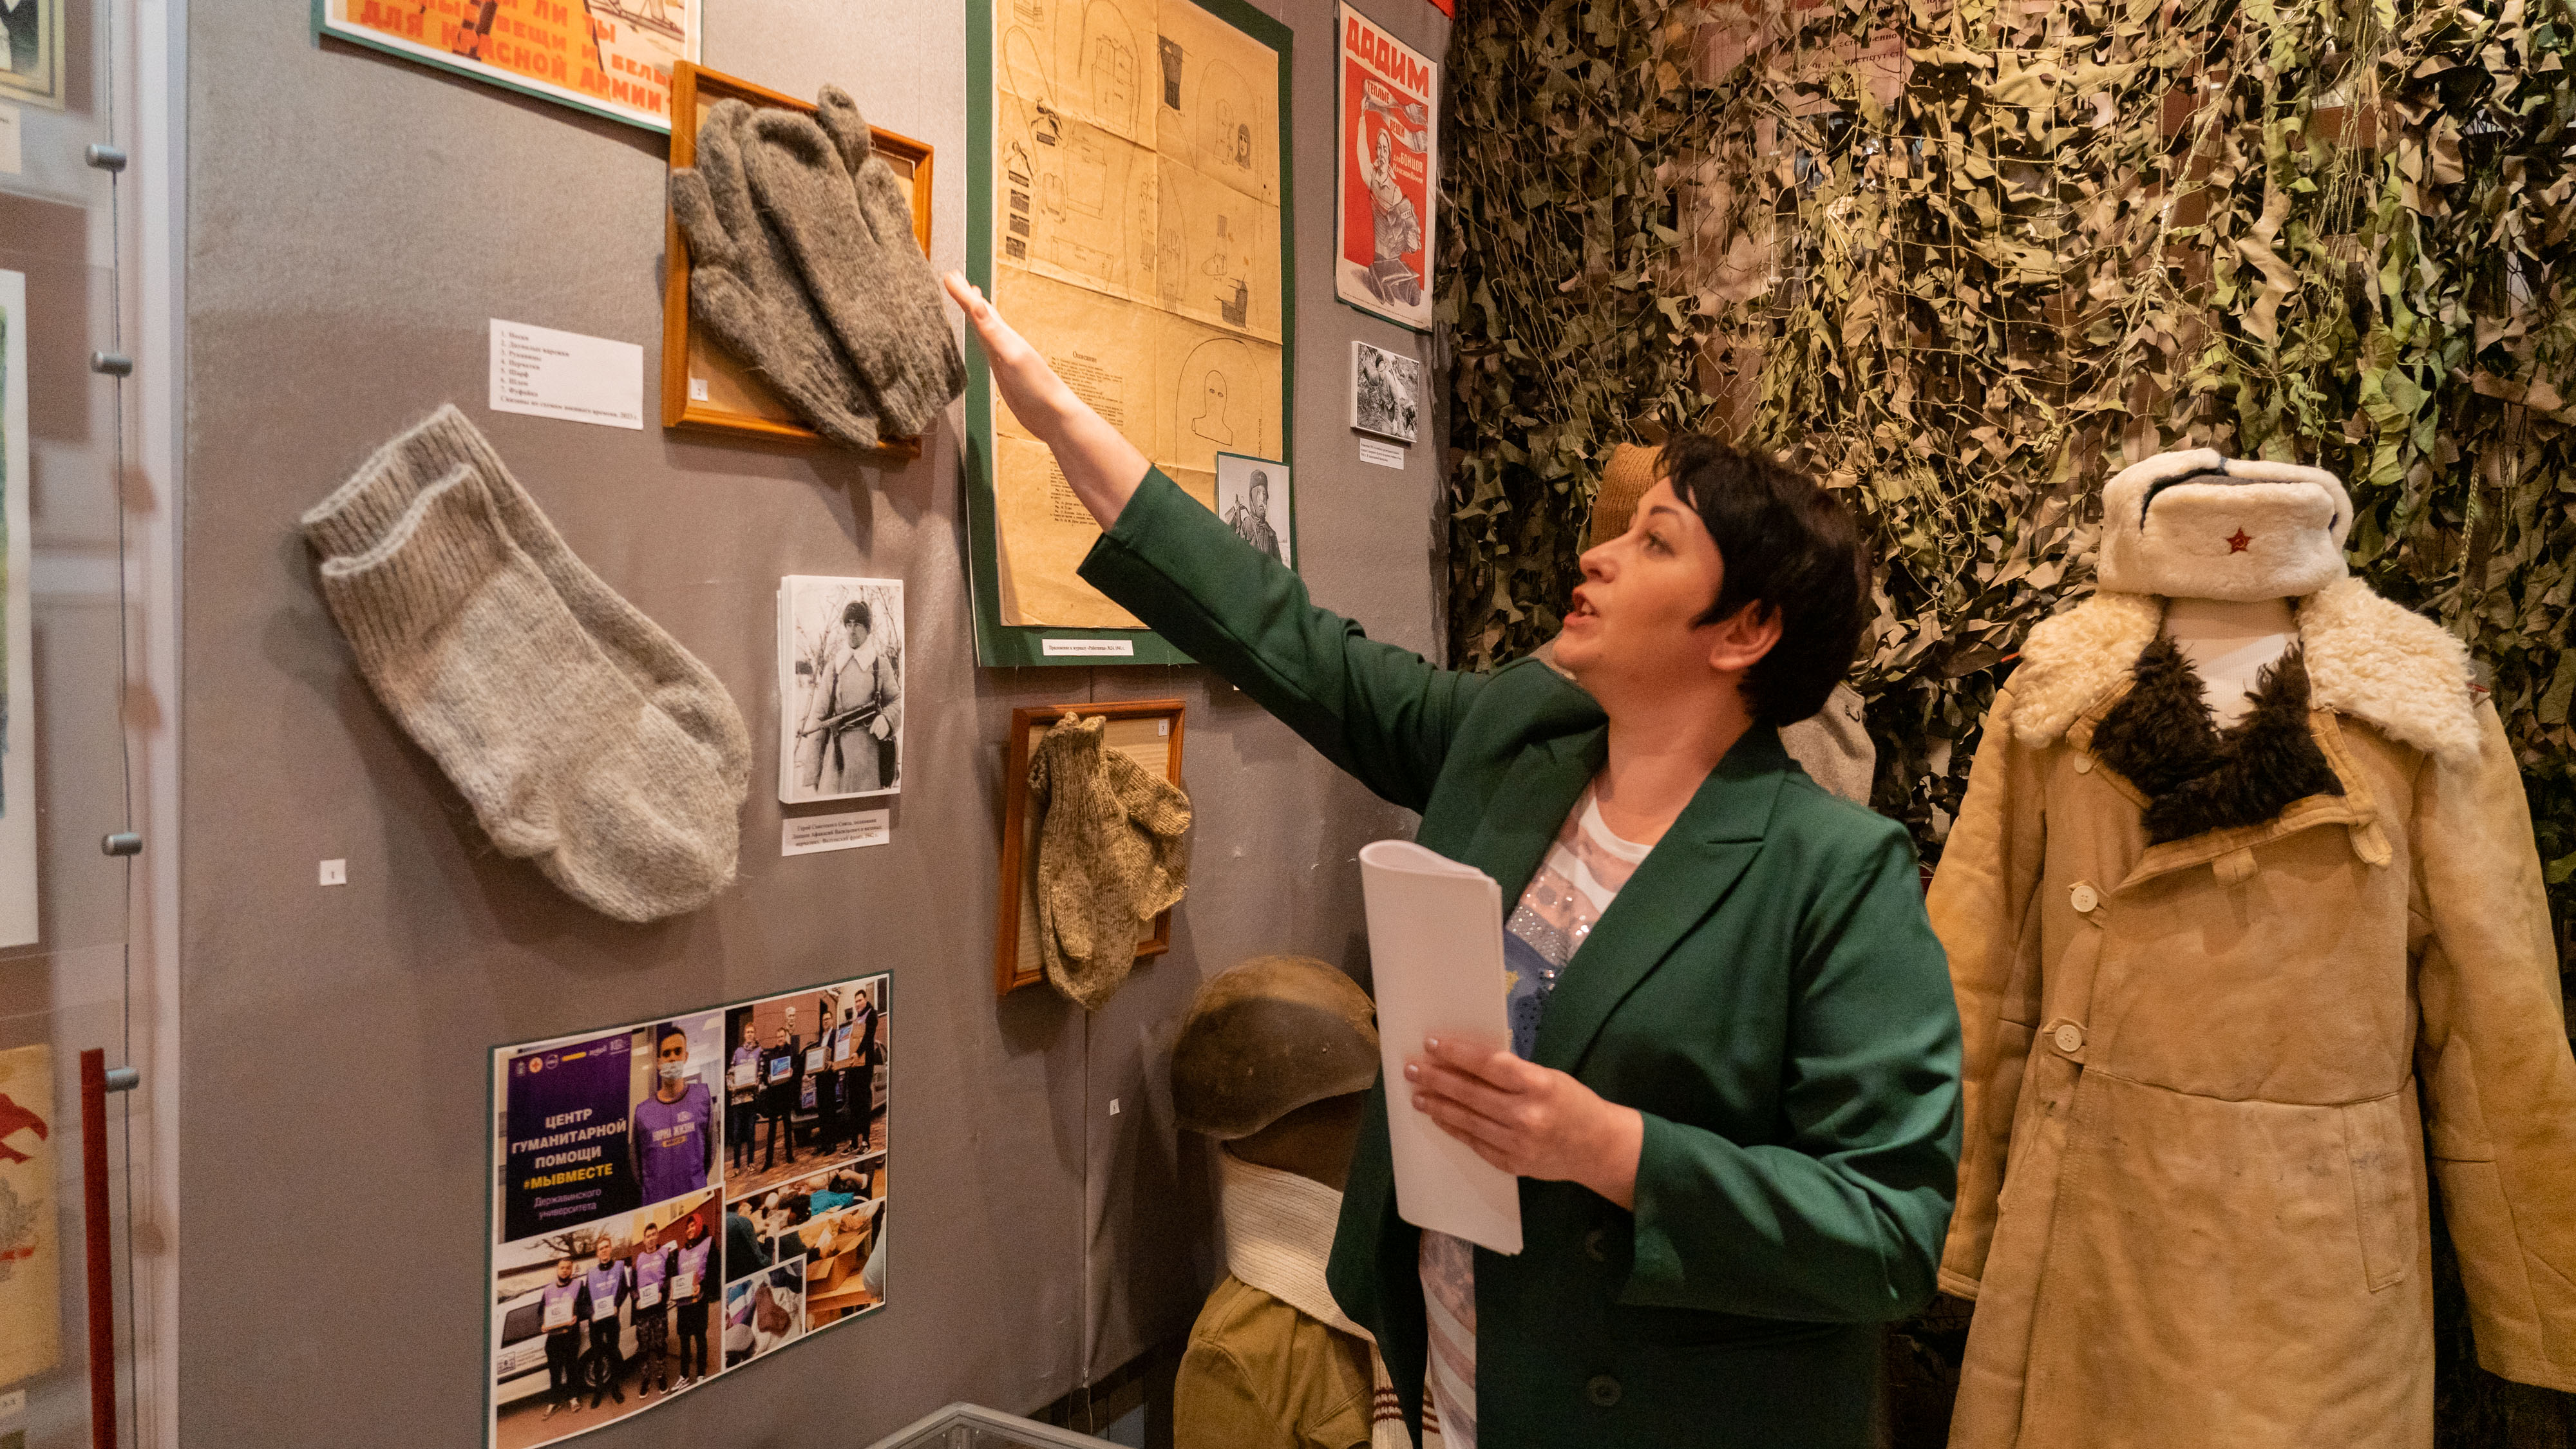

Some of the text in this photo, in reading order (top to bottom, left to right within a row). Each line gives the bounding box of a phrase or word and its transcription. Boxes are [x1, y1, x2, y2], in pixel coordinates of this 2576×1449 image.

[533, 0, 616, 44] ЛИ ТЫ
[359, 0, 424, 39] ДЛЯ
[440, 21, 567, 82] КРАСНОЙ
[495, 14, 567, 53] ВЕЩИ
[581, 43, 597, 62] И
[1345, 15, 1429, 99] ДАДИМ
[1367, 80, 1390, 105] ТЕПЛЫЕ
[1389, 118, 1405, 138] ВЕЩИ
[1072, 351, 1097, 364] Описание
[509, 369, 529, 378] Шарф
[545, 1108, 592, 1130] ЦЕНТР
[511, 1117, 627, 1154] ГУМАНИТАРНОЙ
[534, 1145, 602, 1170] ПОМОЩИ
[523, 1162, 614, 1190] #МЫВМЕСТЕ
[534, 1188, 602, 1208] Державинского
[539, 1202, 597, 1220] университета
